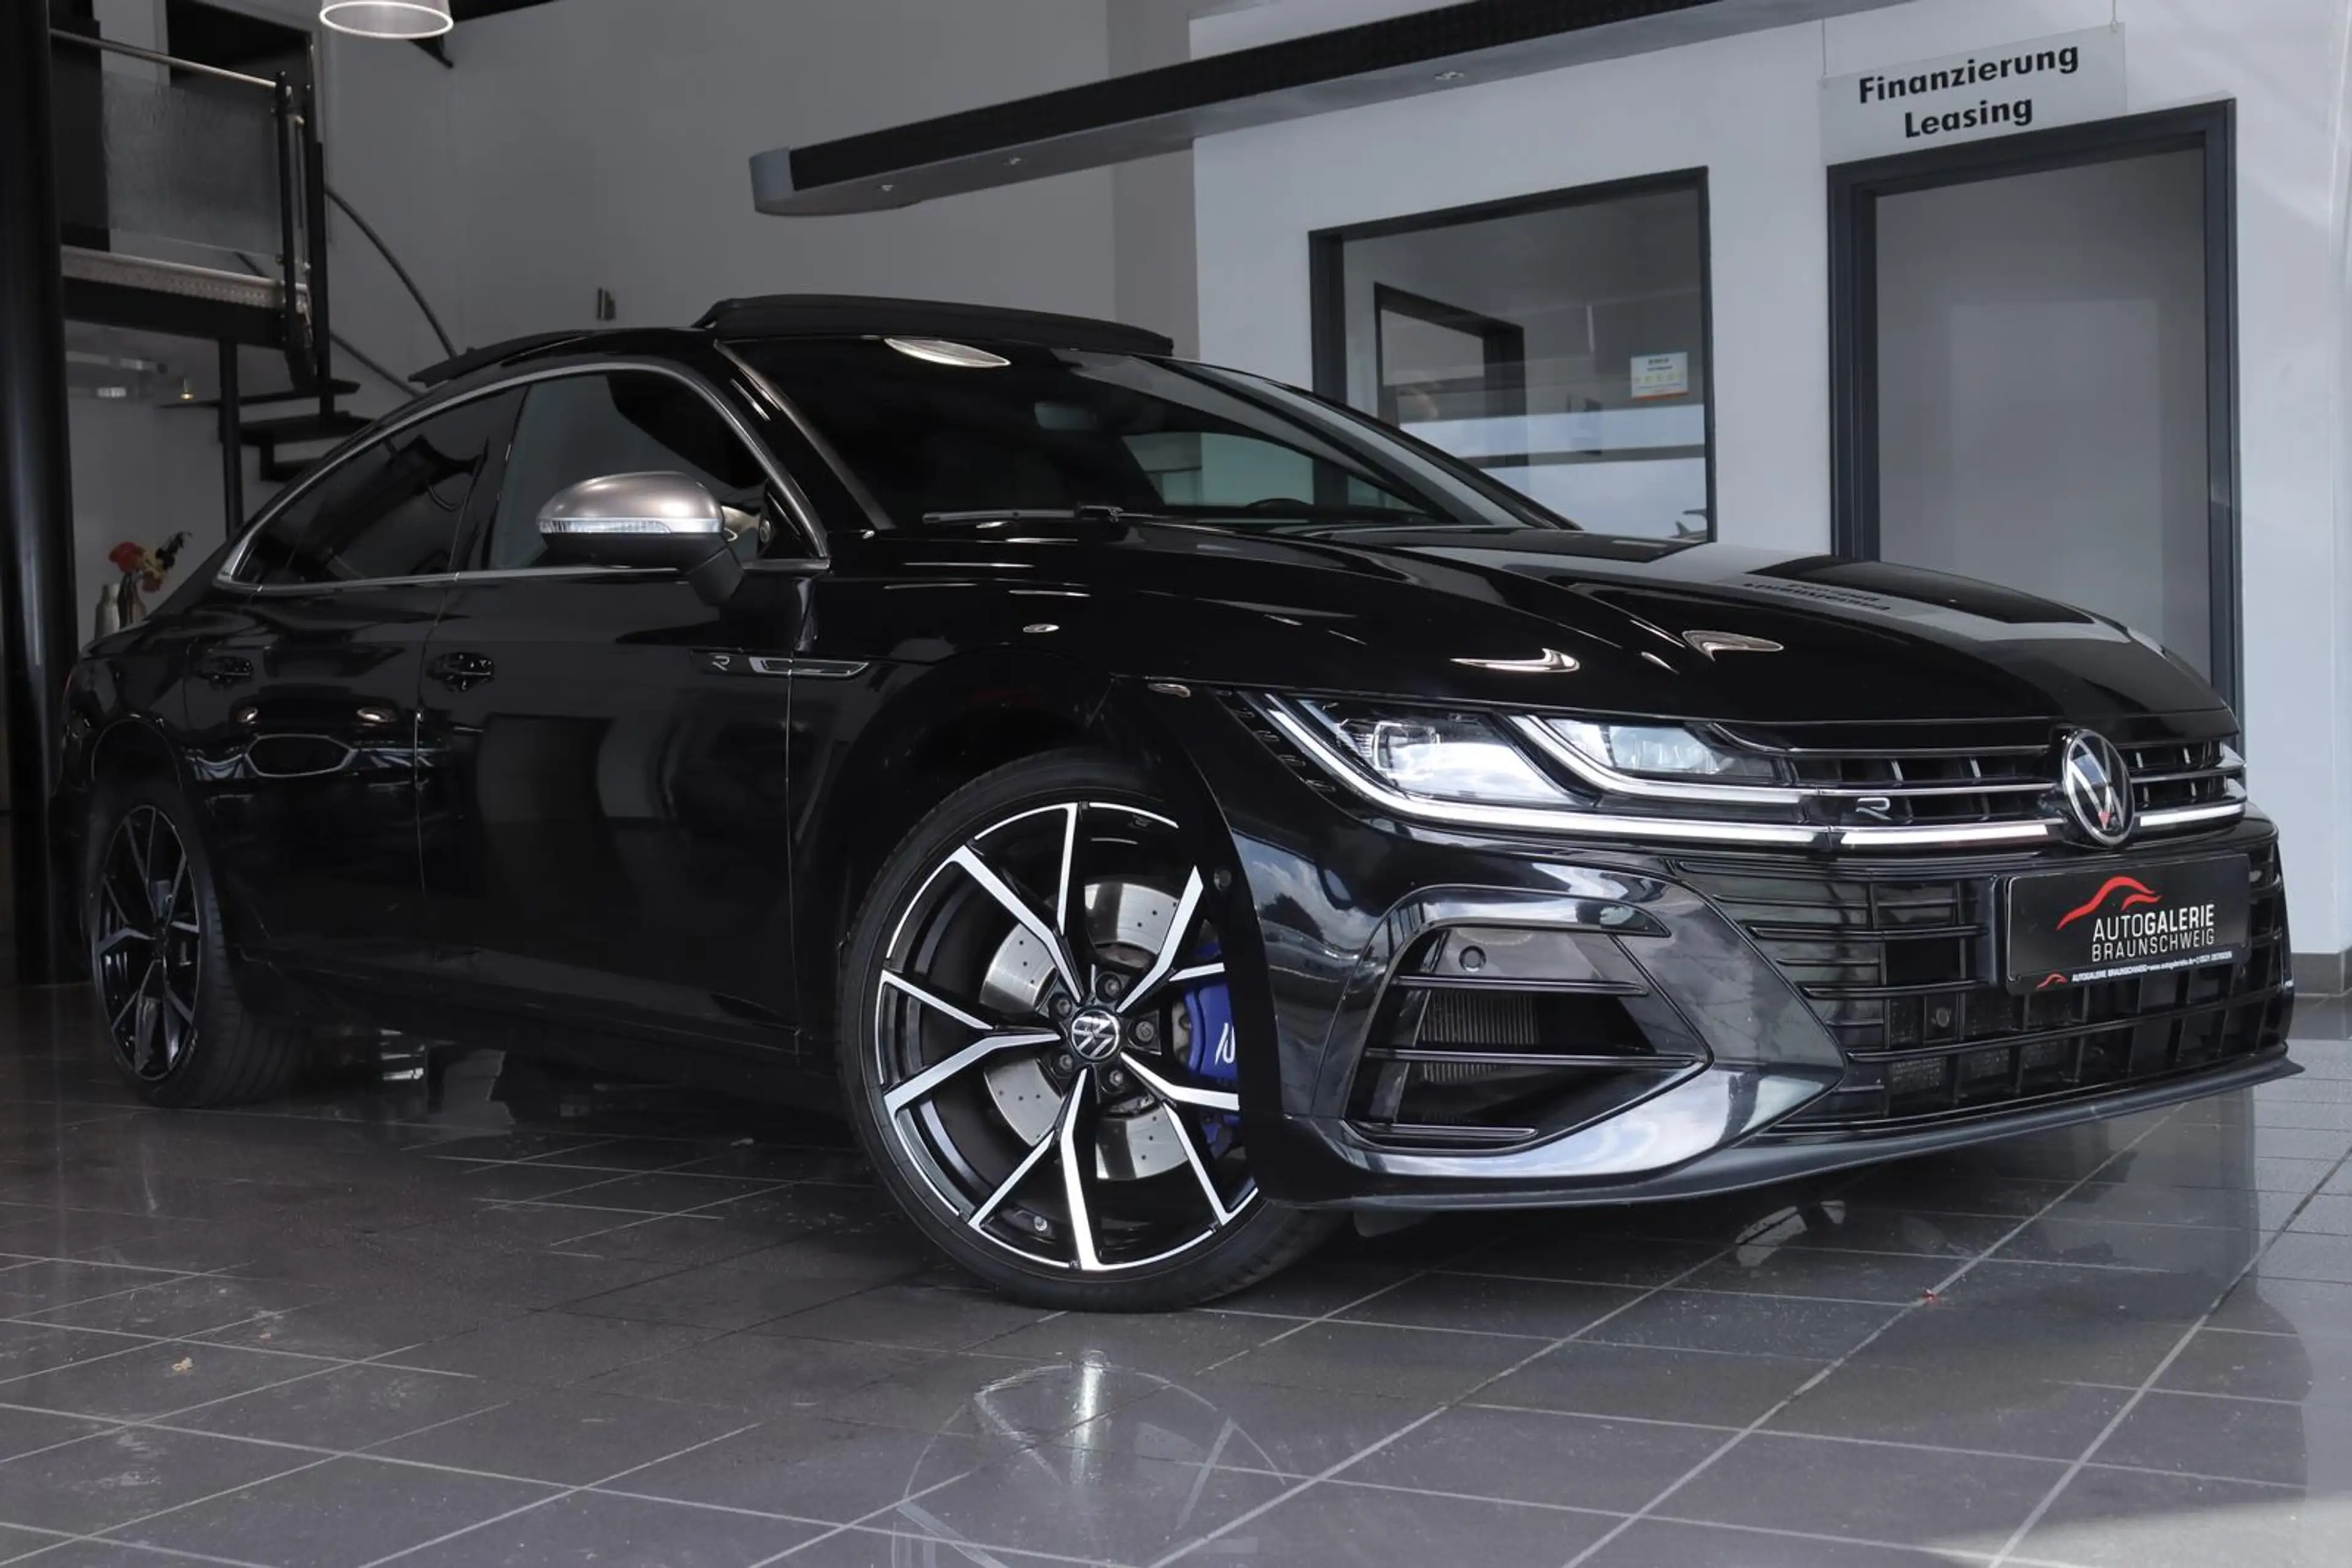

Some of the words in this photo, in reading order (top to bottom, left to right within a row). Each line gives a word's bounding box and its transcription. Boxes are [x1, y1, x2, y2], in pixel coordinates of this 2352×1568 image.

[1860, 46, 2079, 104] Finanzierung
[1904, 99, 2033, 138] Leasing
[1856, 797, 1893, 821] R
[2092, 903, 2215, 943] AUTOGALERIE
[2092, 928, 2215, 962] BRAUNSCHWEIG
